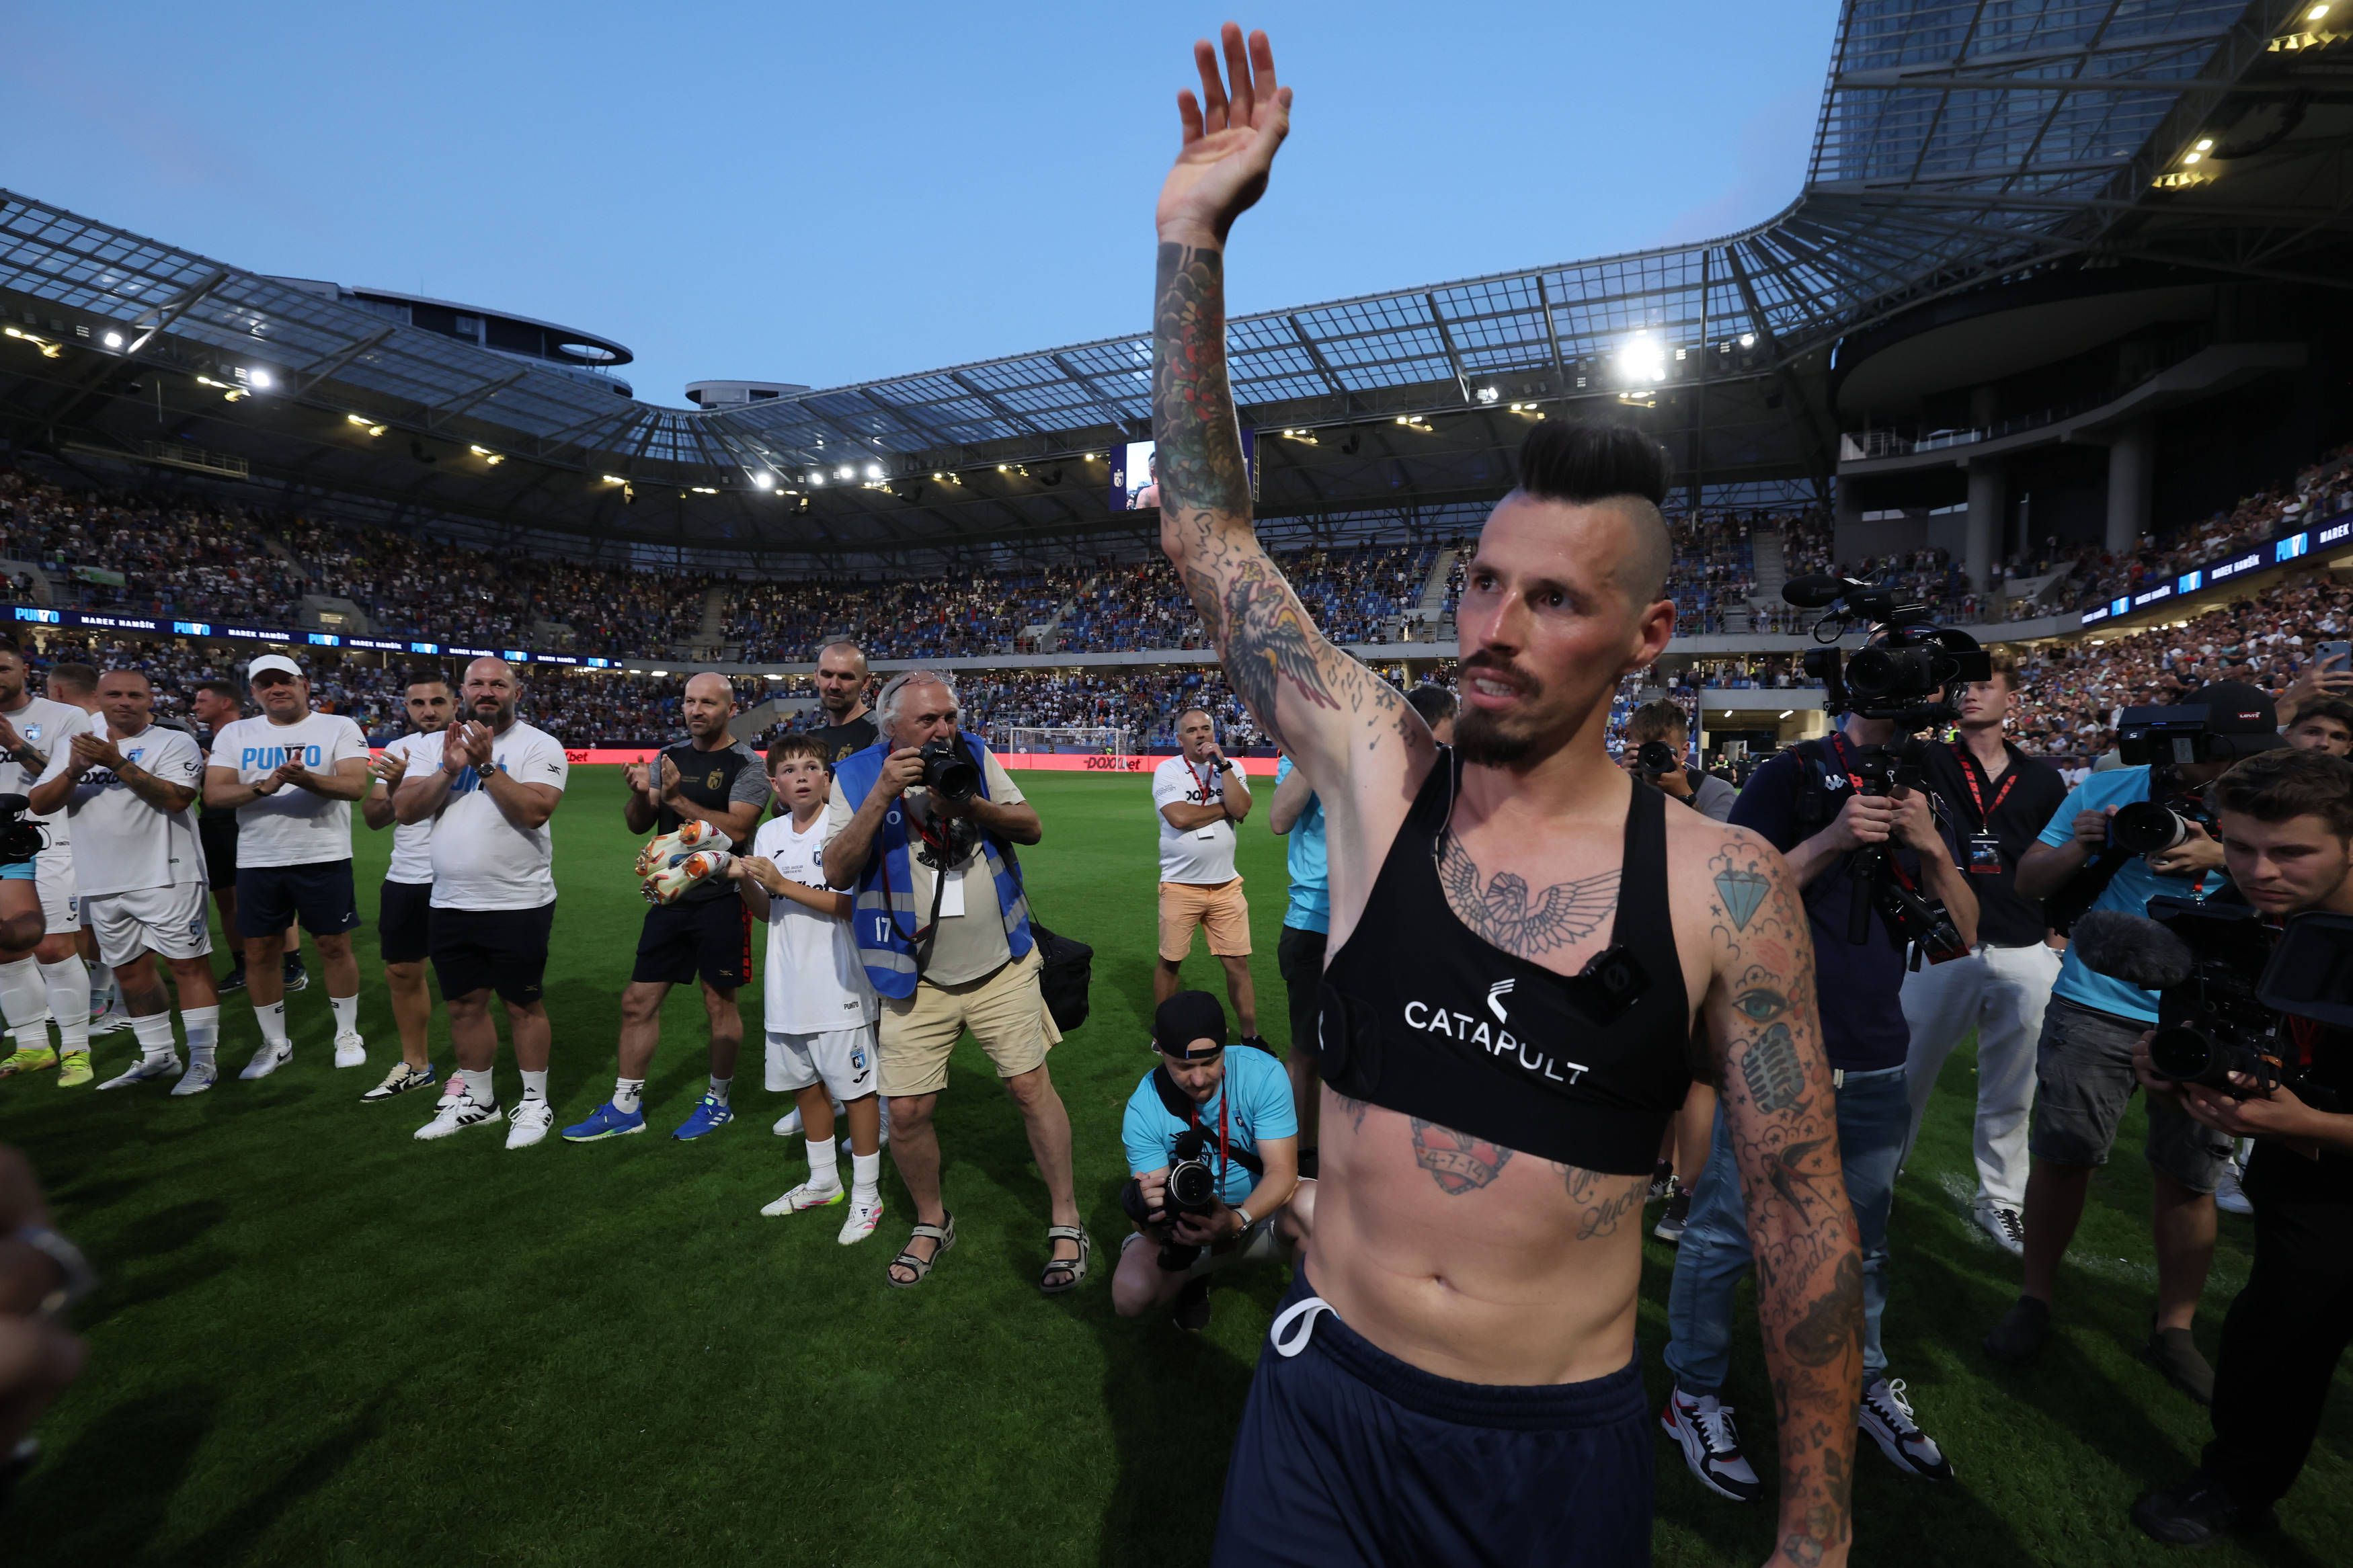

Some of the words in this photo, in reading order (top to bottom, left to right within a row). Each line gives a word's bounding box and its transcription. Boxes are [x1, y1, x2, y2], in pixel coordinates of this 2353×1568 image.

[2320, 524, 2350, 544] MAREK
[81, 616, 115, 626] MAREK
[118, 619, 155, 629] HAMŠÍK
[228, 629, 257, 638] MAREK
[259, 632, 290, 641] HAMŠÍK
[876, 917, 891, 942] 17
[1404, 1001, 1589, 1085] CATAPULT
